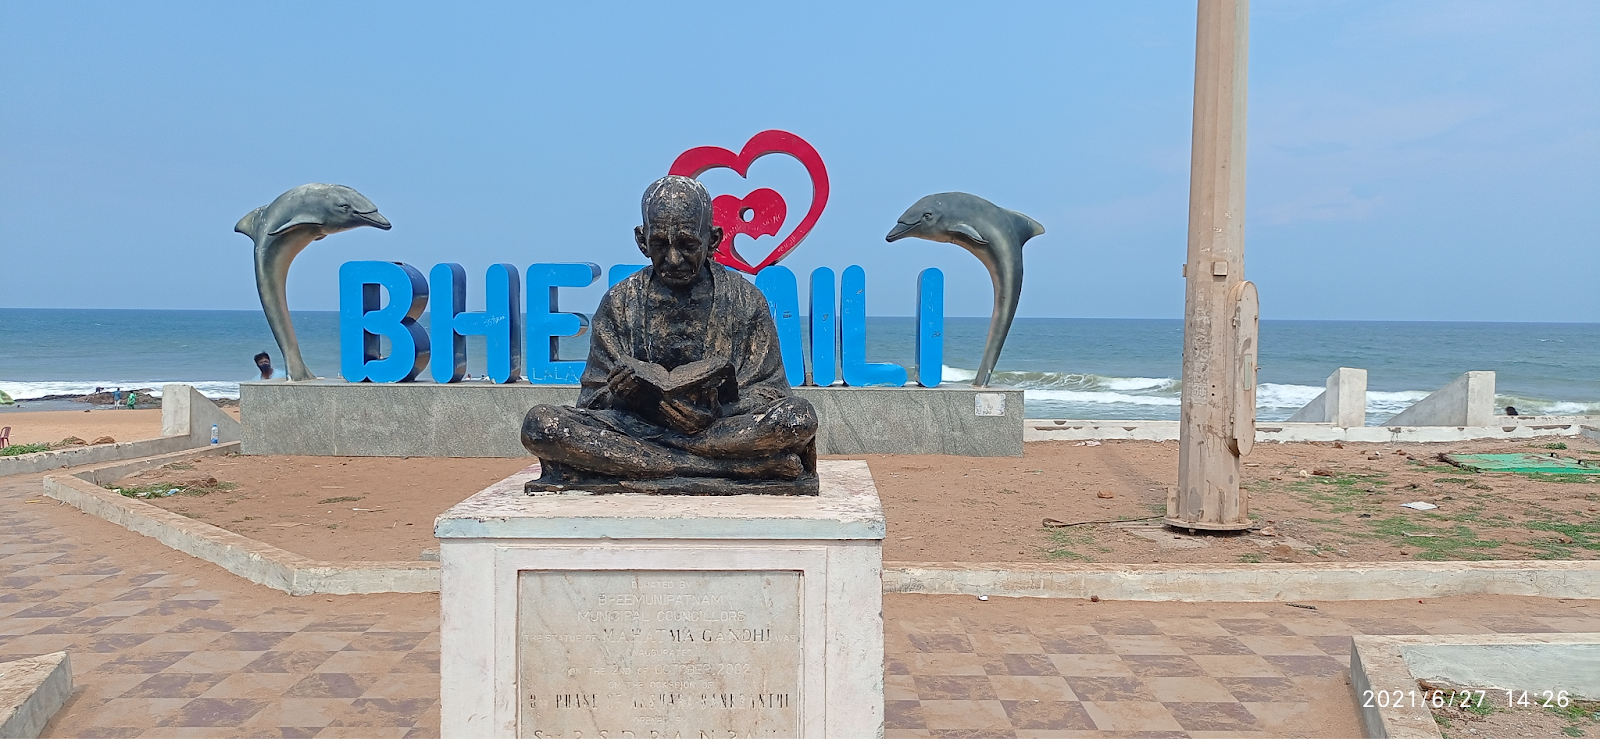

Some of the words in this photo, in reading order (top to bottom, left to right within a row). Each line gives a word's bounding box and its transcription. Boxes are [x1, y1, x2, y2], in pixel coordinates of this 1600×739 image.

[577, 610, 650, 622] MUNICIPAL
[656, 610, 747, 622] COUNCILLORS
[545, 634, 582, 643] STATUE
[702, 628, 771, 643] GANDHI
[556, 693, 598, 709] PHASE
